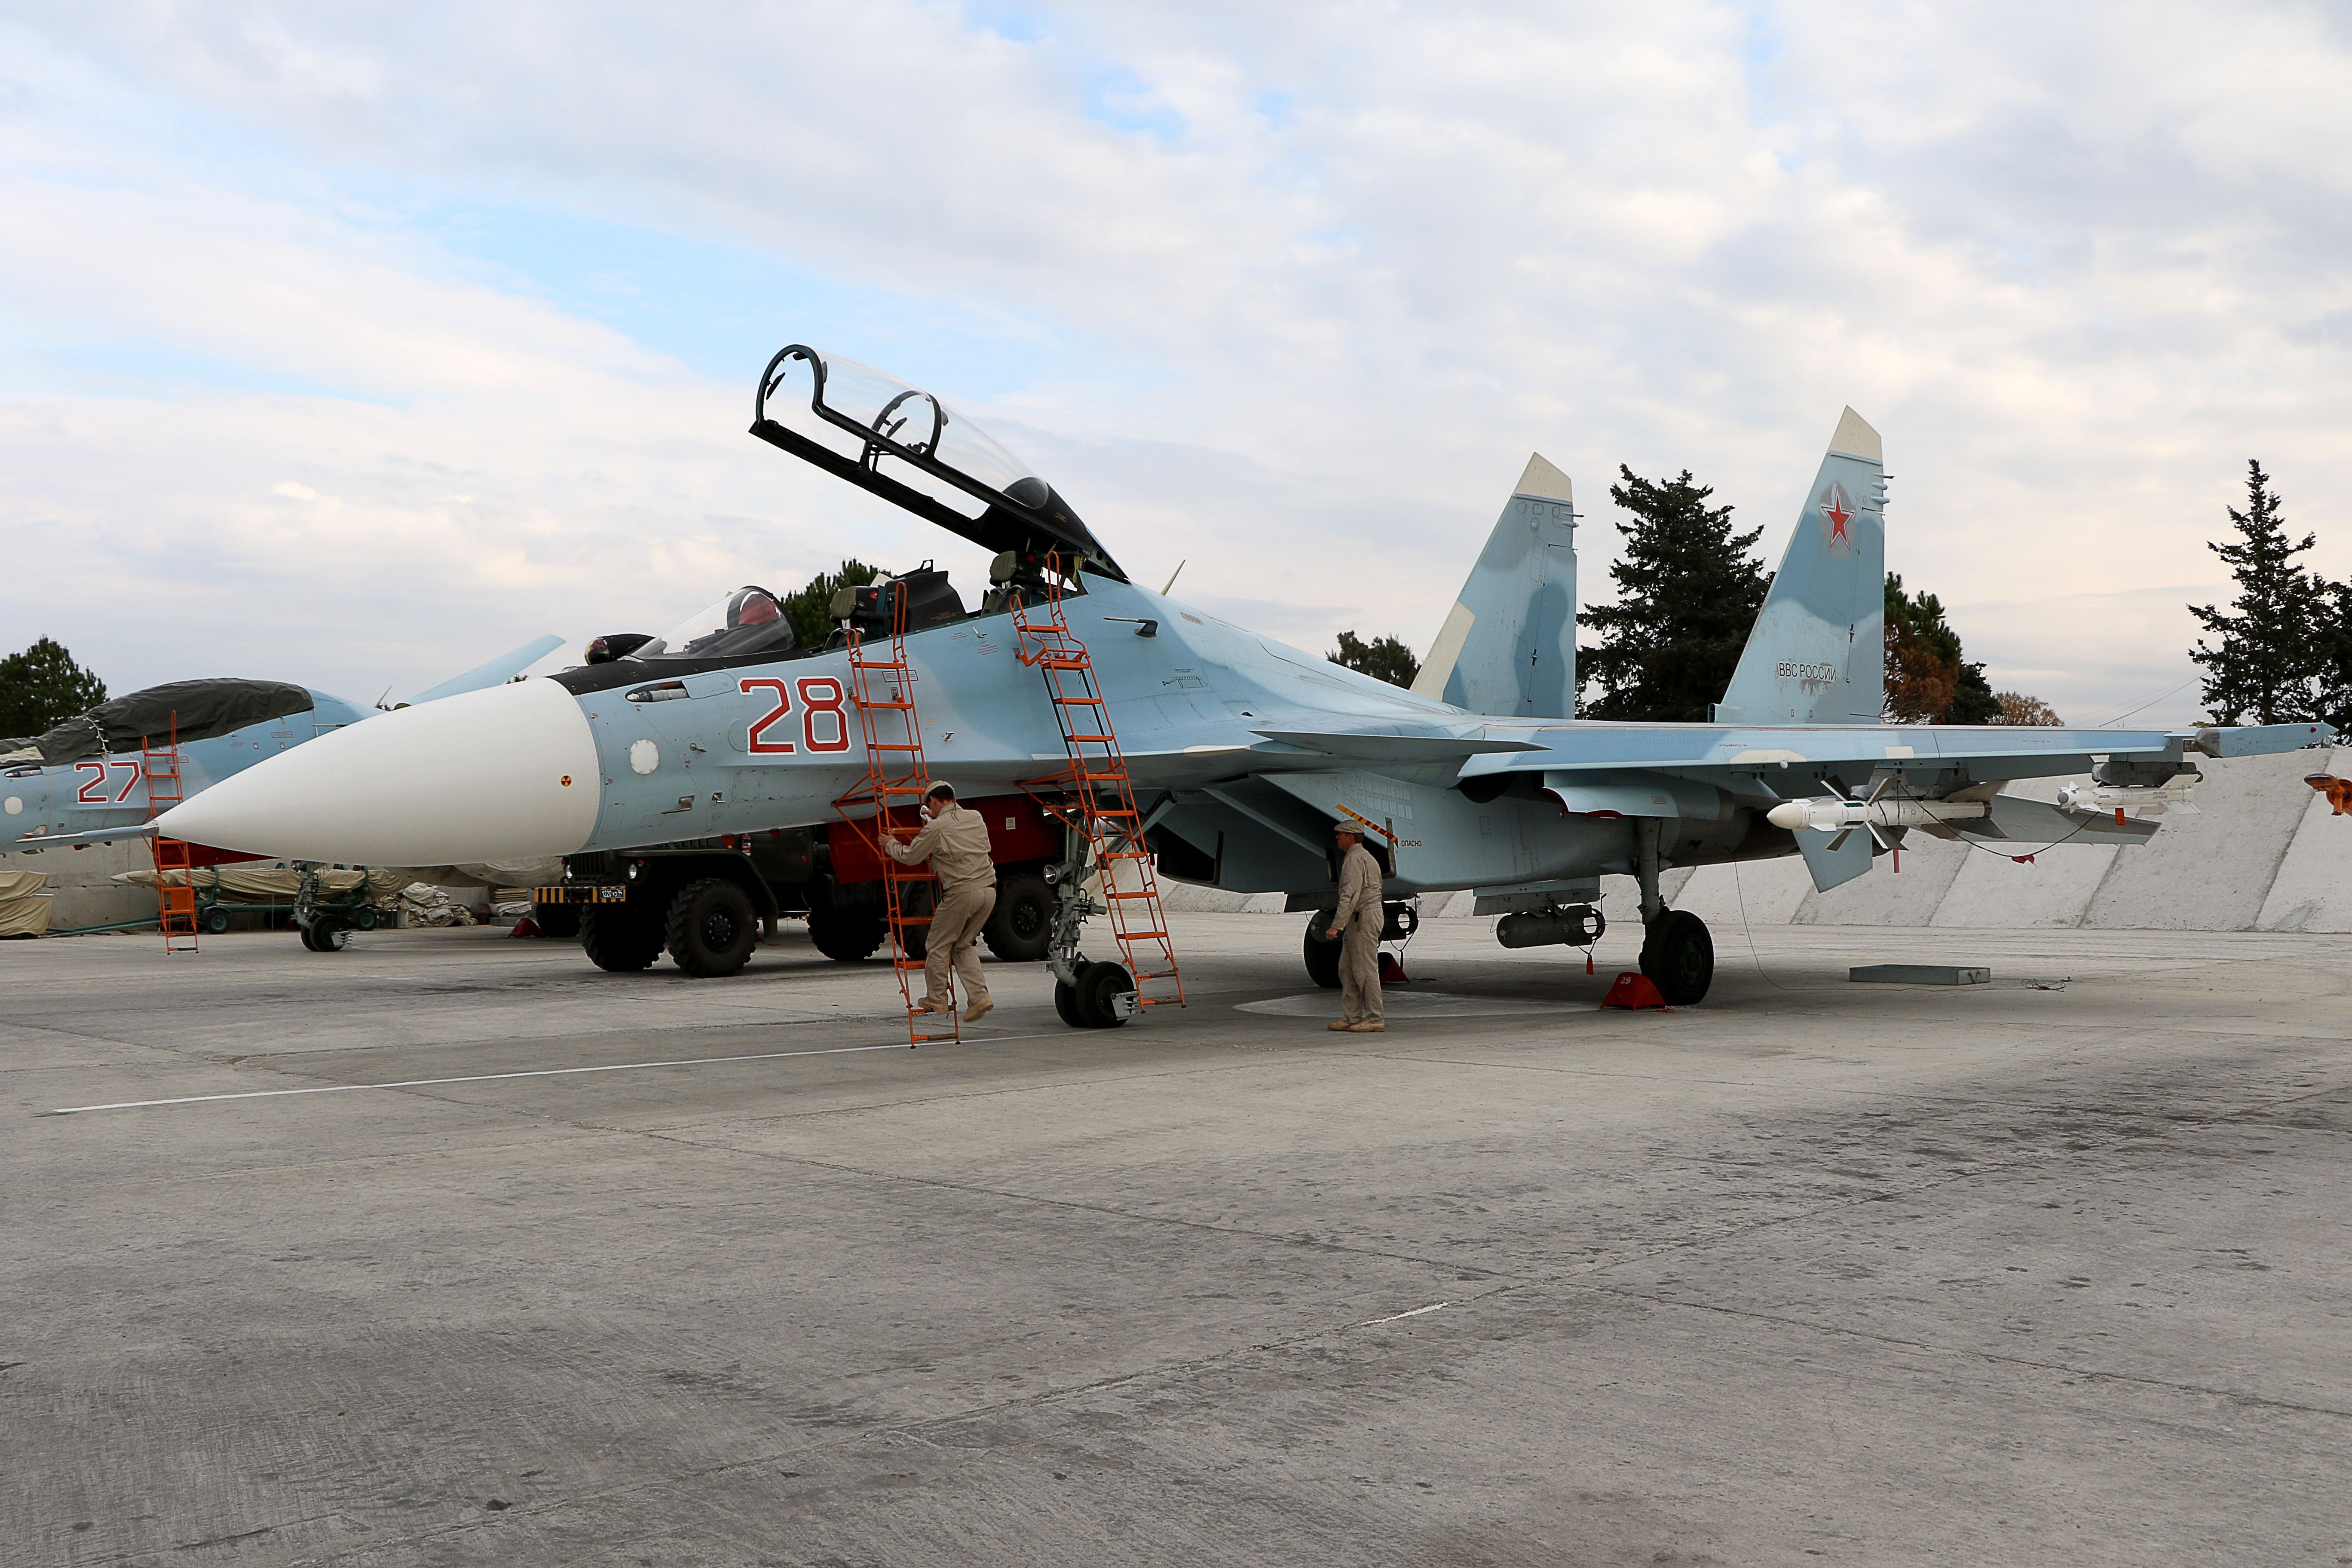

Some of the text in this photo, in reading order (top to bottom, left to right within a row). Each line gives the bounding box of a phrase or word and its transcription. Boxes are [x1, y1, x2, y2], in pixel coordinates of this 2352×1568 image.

[1779, 662, 1837, 681] ВВС РОССИИ
[737, 676, 852, 756] 28
[74, 760, 141, 804] 27
